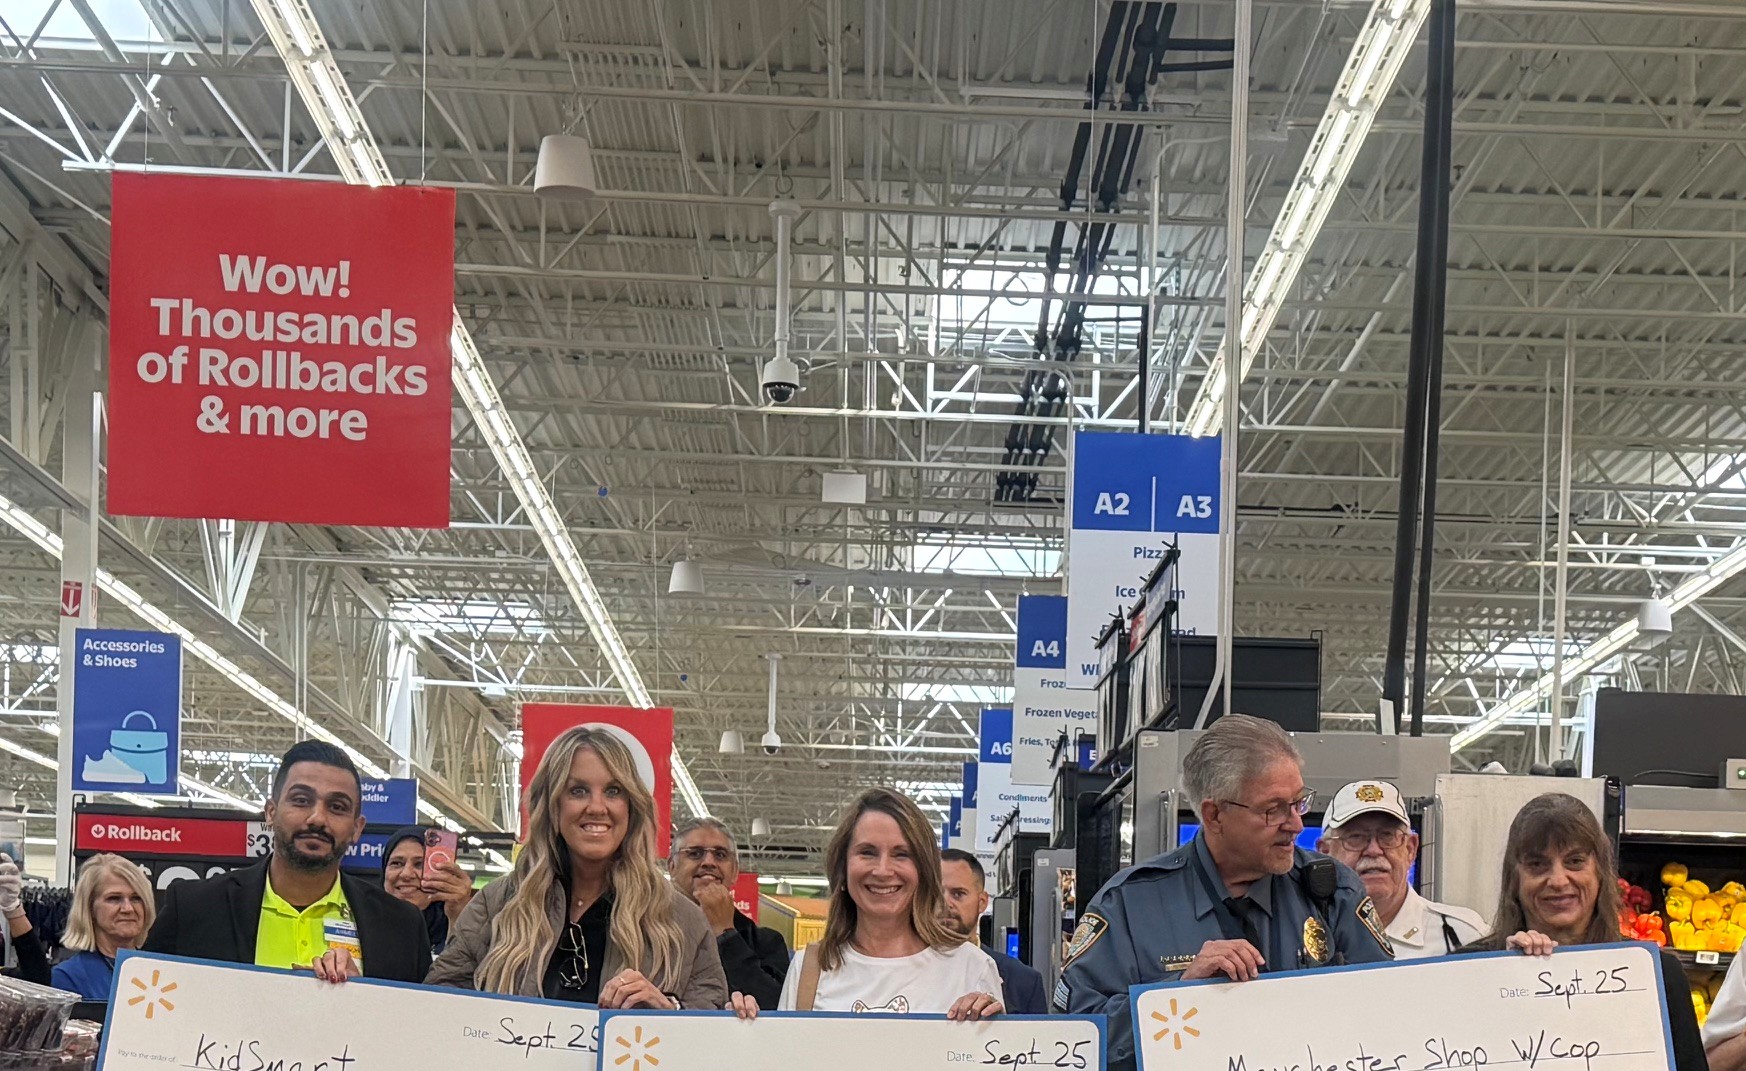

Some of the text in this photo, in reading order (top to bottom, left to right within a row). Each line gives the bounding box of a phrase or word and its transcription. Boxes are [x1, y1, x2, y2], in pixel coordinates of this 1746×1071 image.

[218, 253, 351, 298] Wow!
[150, 297, 418, 348] Thousands
[136, 345, 429, 396] of Rollbacks
[196, 395, 368, 441] & more
[1094, 492, 1130, 516] A2
[1176, 495, 1212, 519] A3
[1133, 546, 1168, 559] Pizz
[1115, 585, 1137, 598] Ice
[83, 638, 165, 653] Accessories
[1031, 640, 1060, 657] A4
[82, 654, 137, 668] & Shoes
[1040, 679, 1066, 688] Froz
[1025, 707, 1098, 720] Frozen Veget
[990, 742, 1012, 755] A6
[998, 793, 1048, 803] Condiments
[107, 824, 182, 843] Rollback
[1595, 966, 1630, 994] 25
[1054, 1040, 1092, 1070] 25
